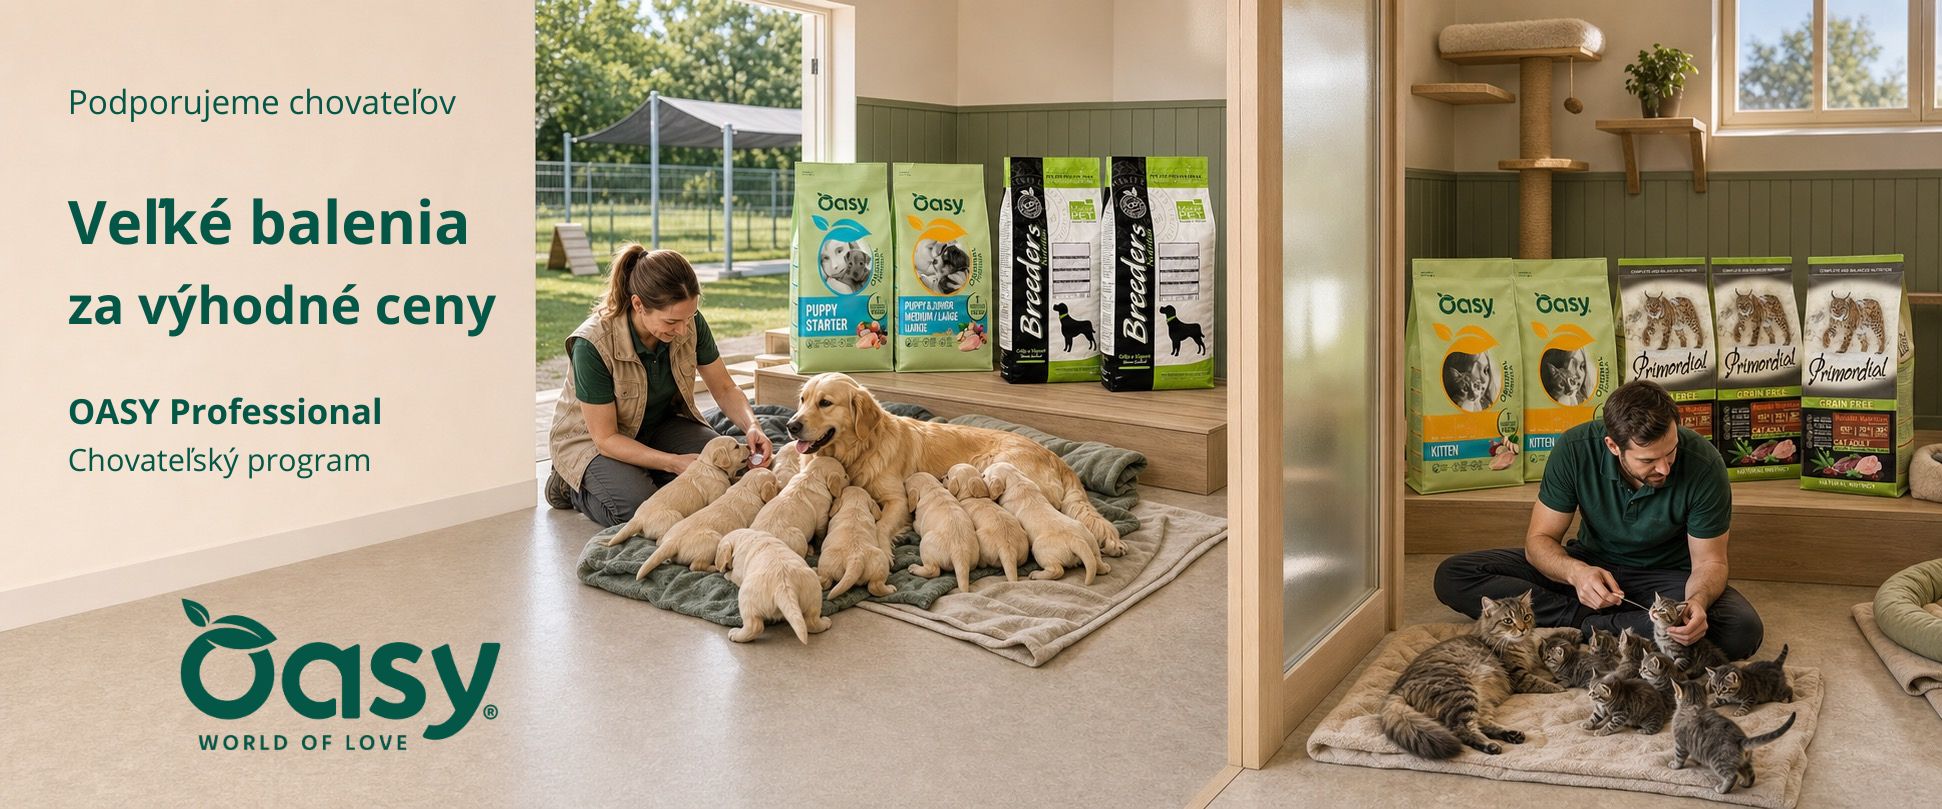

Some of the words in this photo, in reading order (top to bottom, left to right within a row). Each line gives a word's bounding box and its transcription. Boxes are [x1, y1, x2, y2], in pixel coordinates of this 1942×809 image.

[818, 193, 868, 214] Oasy
[913, 193, 963, 215] Oasy
[1017, 224, 1043, 339] Breeders
[1120, 224, 1148, 344] Breeders
[806, 304, 837, 316] PUPPY
[1437, 293, 1493, 318] Oasy
[1535, 292, 1589, 316] Oasy
[806, 319, 848, 331] STARTER
[1632, 351, 1707, 381] Primordial
[1725, 347, 1796, 378] Primordial
[1809, 353, 1888, 385] Primordial
[1737, 389, 1764, 398] GRAIN
[1820, 399, 1848, 408] GRAIN
[1850, 400, 1874, 408] FREE
[1431, 445, 1458, 457] KITTEN
[1529, 438, 1555, 447] KITTEN
